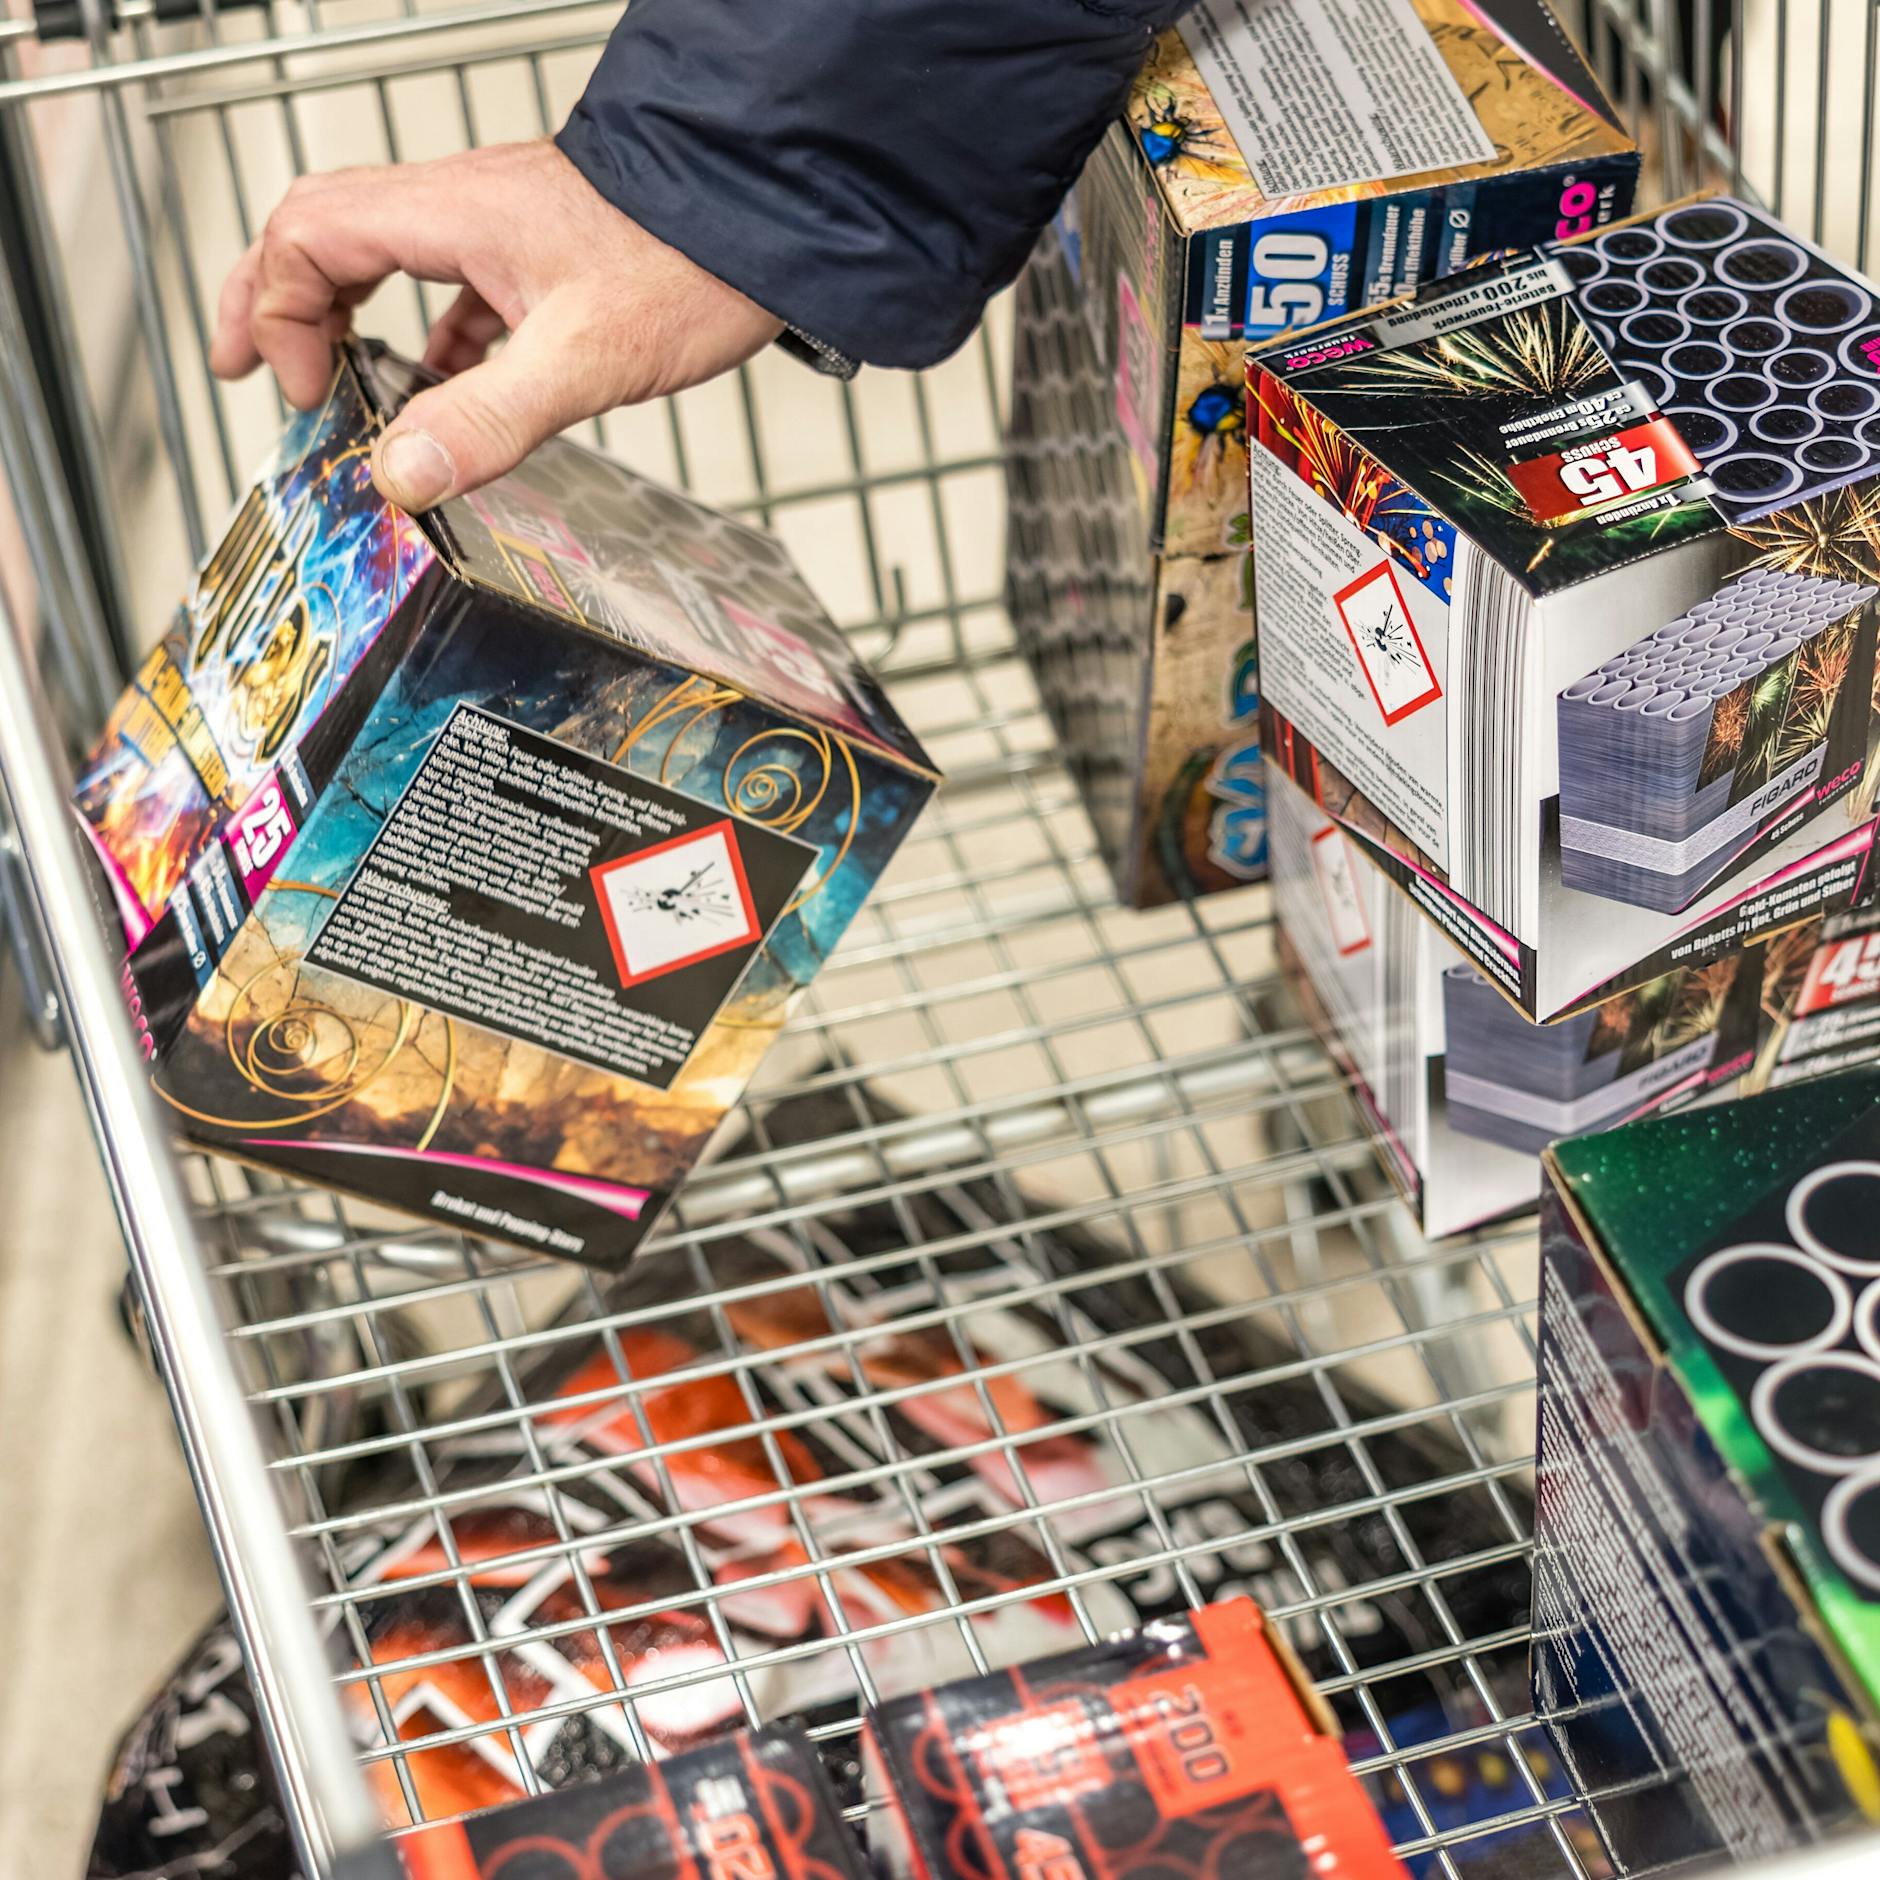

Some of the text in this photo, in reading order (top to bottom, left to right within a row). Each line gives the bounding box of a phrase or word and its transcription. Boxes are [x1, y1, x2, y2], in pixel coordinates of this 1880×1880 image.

[1378, 204, 1400, 274] Brenndauer
[1204, 239, 1234, 325] 1x Anzünden
[1250, 232, 1328, 326] 50
[1327, 253, 1350, 306] SCHUSS
[1484, 277, 1528, 302] 200
[1527, 269, 1549, 283] bis
[1387, 293, 1471, 329] Effektladung
[1432, 283, 1557, 331] Batterie-Feuerwerk
[1499, 409, 1567, 435] Effekthöhe
[1505, 422, 1579, 449] Brenndauer
[1561, 437, 1621, 464] SCHUSS
[1559, 446, 1657, 506] 45
[1596, 493, 1682, 525] 1x Anzünden
[456, 709, 511, 741] Achtung:
[1750, 758, 1818, 816] FIGARO
[241, 787, 292, 870] 25
[359, 869, 450, 912] Waarschuwing:
[1739, 860, 1857, 918] Gold-Kometen gefolgt
[1671, 942, 1692, 959] von
[1693, 925, 1736, 952] Buketts
[1822, 877, 1856, 899] Silber
